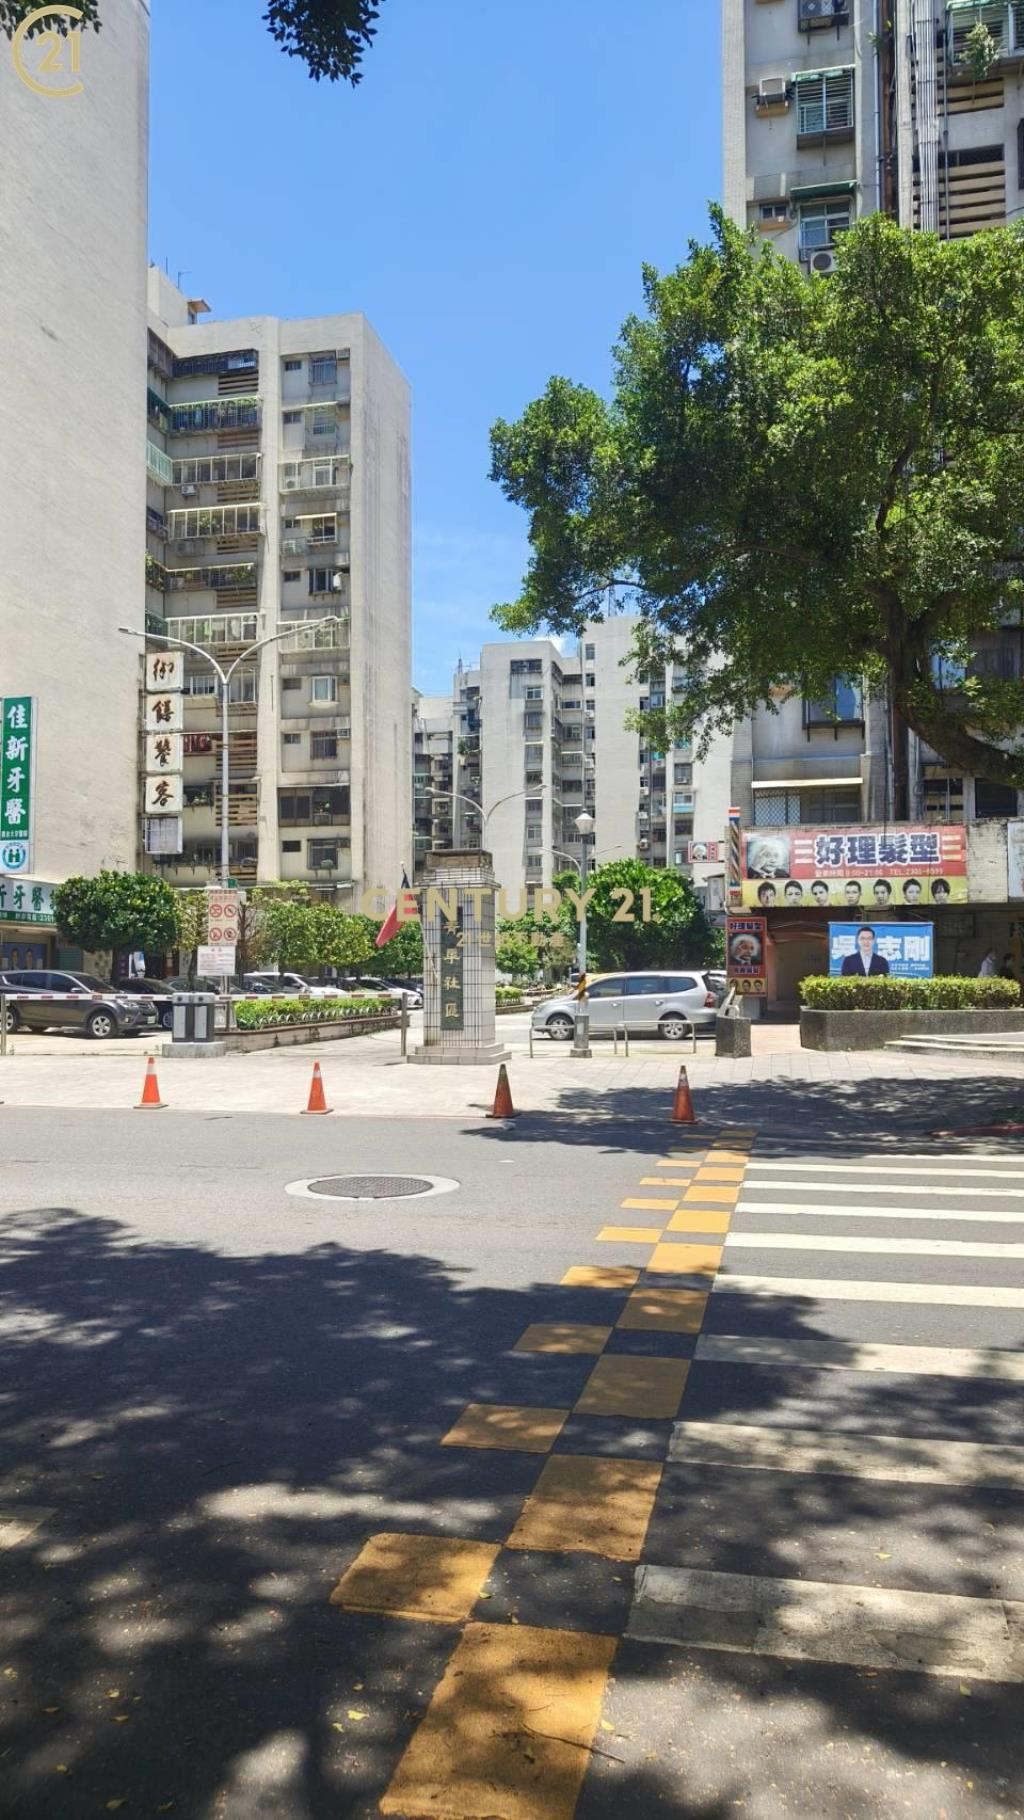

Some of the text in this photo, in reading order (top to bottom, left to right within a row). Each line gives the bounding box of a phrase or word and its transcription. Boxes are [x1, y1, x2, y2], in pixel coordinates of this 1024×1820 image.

[5, 704, 29, 825] 佳新牙醫
[815, 833, 941, 868] 好理髮型
